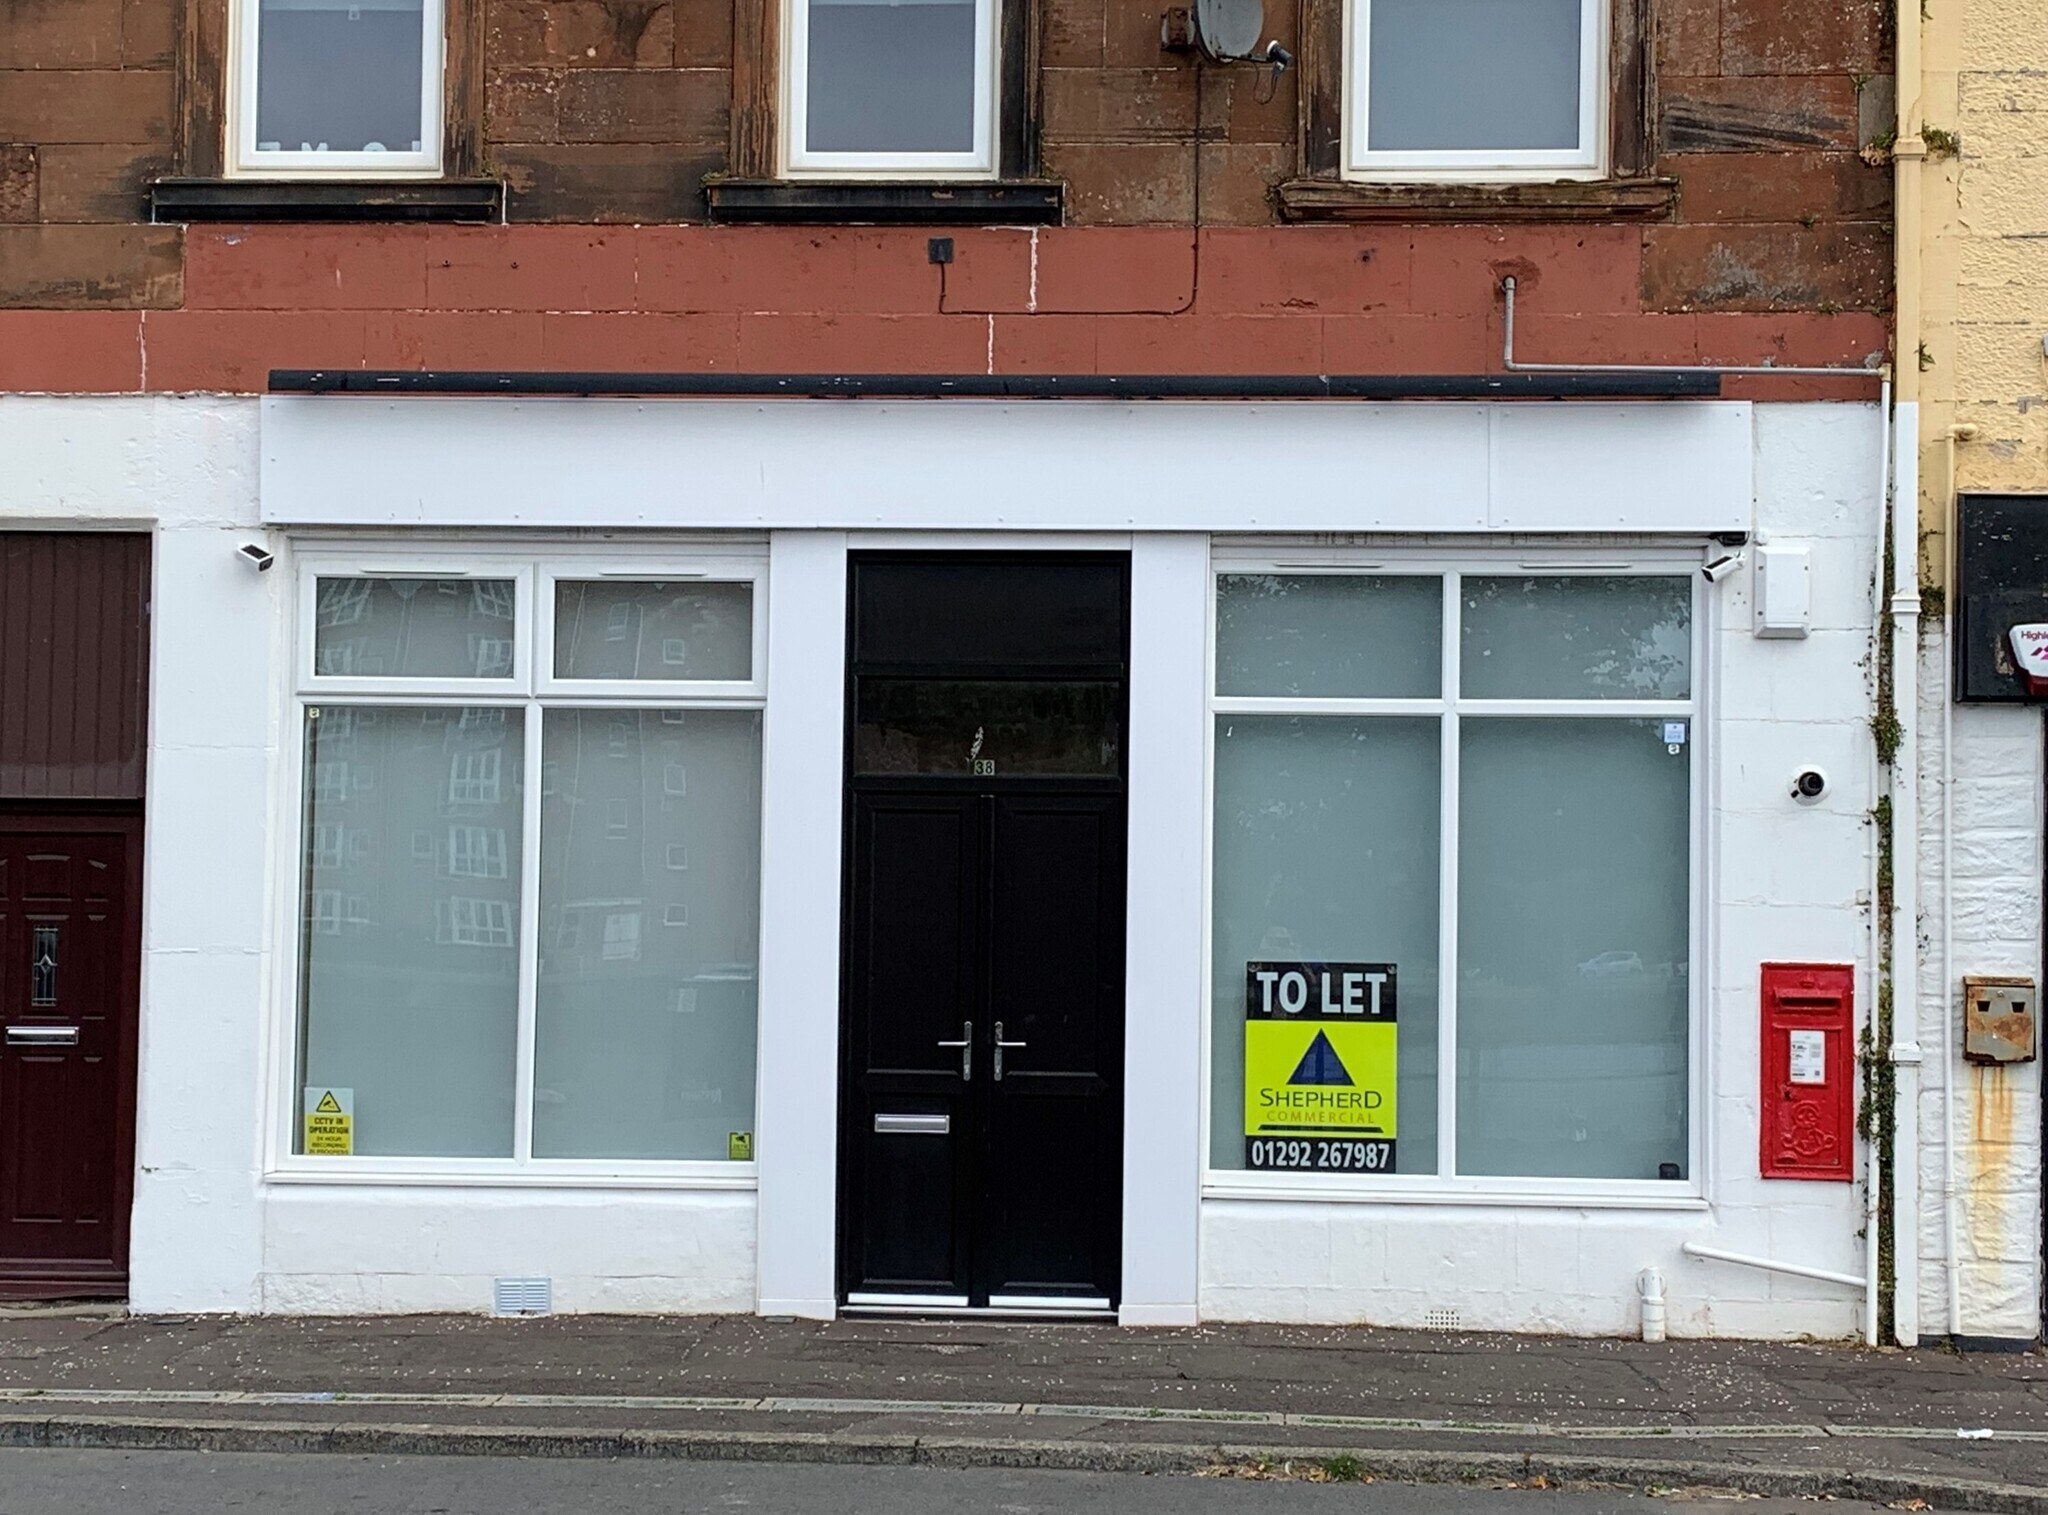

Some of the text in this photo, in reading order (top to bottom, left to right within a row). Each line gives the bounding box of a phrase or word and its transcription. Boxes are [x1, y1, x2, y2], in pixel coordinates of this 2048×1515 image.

[975, 761, 993, 775] 38
[1256, 971, 1387, 1014] TO LET
[1260, 1088, 1382, 1109] SHEPHERD
[314, 1117, 343, 1125] CCTV IN
[1266, 1110, 1375, 1124] COMMERCIAL
[309, 1126, 349, 1134] OPERATION
[1252, 1140, 1390, 1169] 01292 267987
